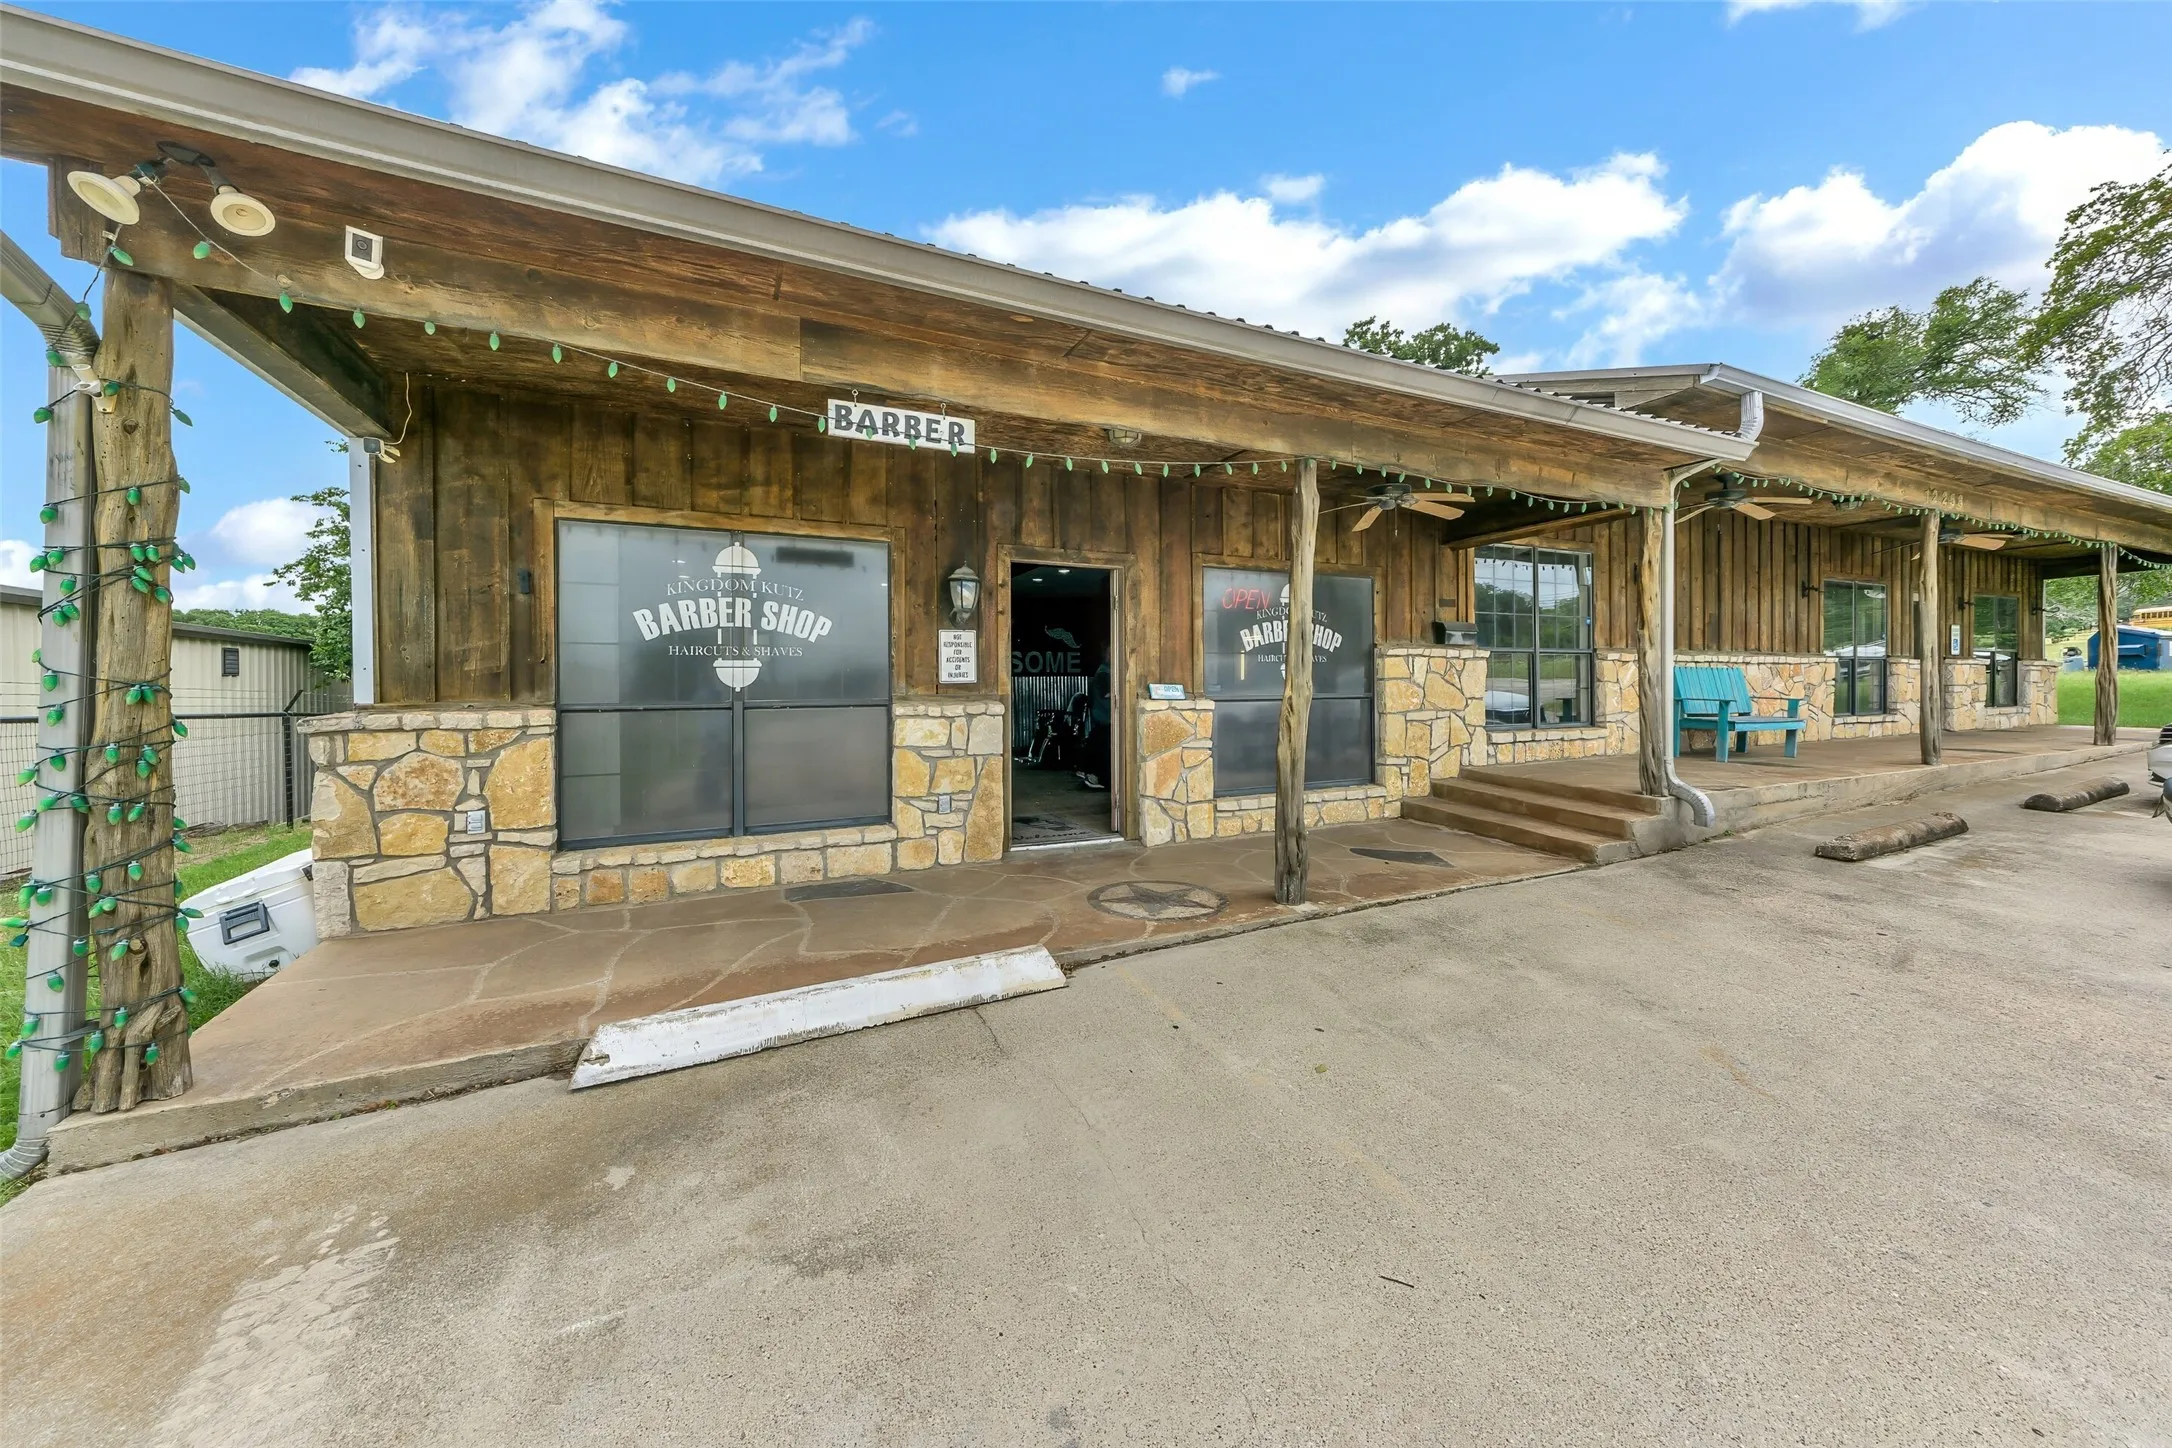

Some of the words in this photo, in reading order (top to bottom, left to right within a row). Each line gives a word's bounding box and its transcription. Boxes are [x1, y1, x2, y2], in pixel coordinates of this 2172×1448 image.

[834, 404, 965, 446] BARBER
[667, 578, 755, 596] KINGDOM
[762, 581, 804, 601] KUTZ
[1222, 588, 1271, 610] OPEN
[632, 597, 752, 641] BARBER
[760, 600, 833, 643] SHOP
[1256, 606, 1289, 620] KINGD
[1240, 620, 1289, 652] BARBE
[1312, 624, 1343, 653] HOP
[669, 645, 739, 656] HAIRCUTS
[742, 646, 750, 656] &
[754, 646, 803, 657] SHAVES
